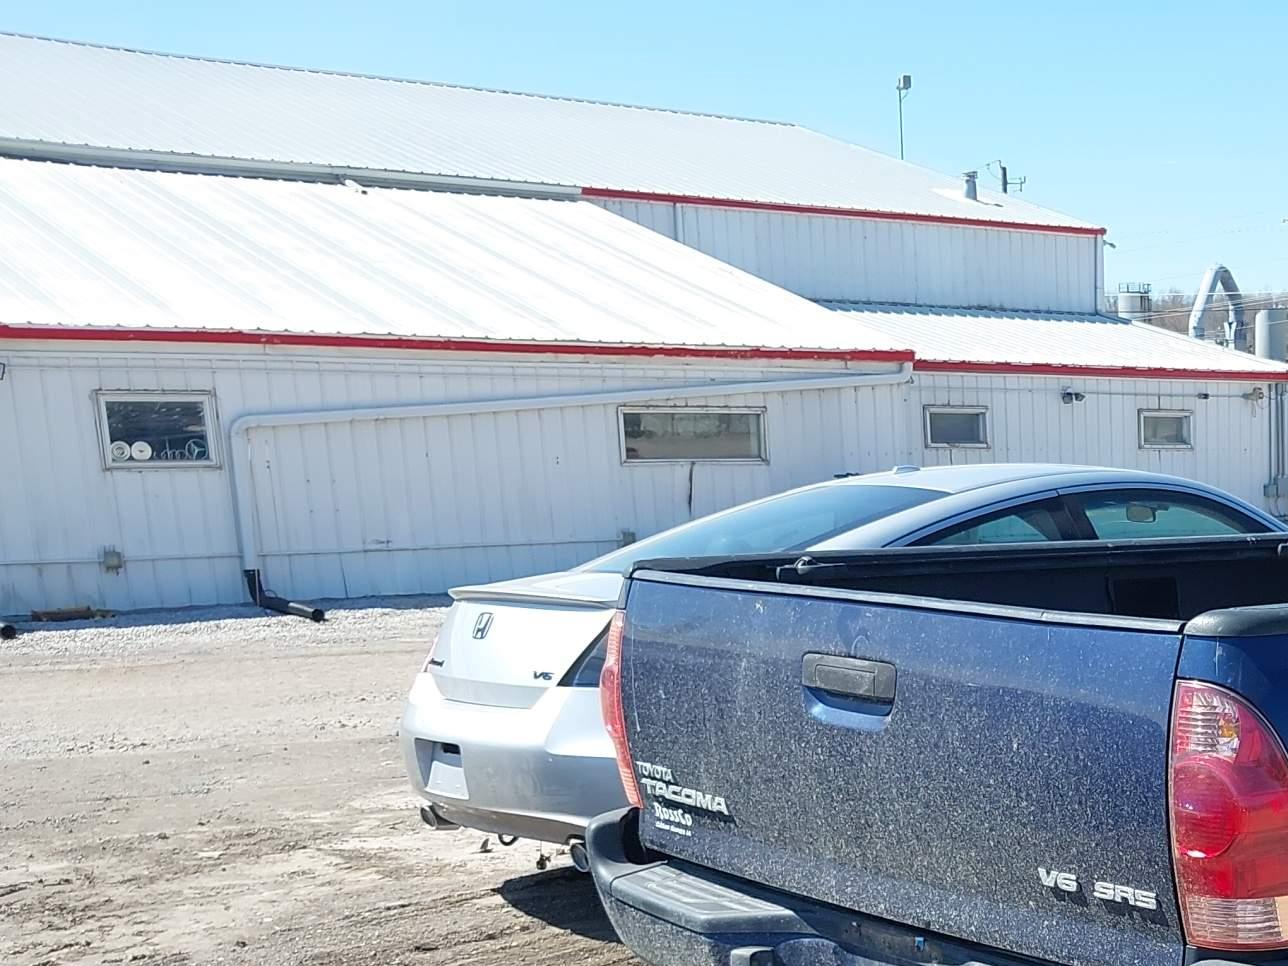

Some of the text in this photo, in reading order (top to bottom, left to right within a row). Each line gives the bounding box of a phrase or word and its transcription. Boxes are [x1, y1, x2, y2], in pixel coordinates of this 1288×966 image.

[635, 760, 674, 782] TOYOTA
[640, 777, 730, 816] TACOMA
[1037, 867, 1157, 911] V6 SR5
